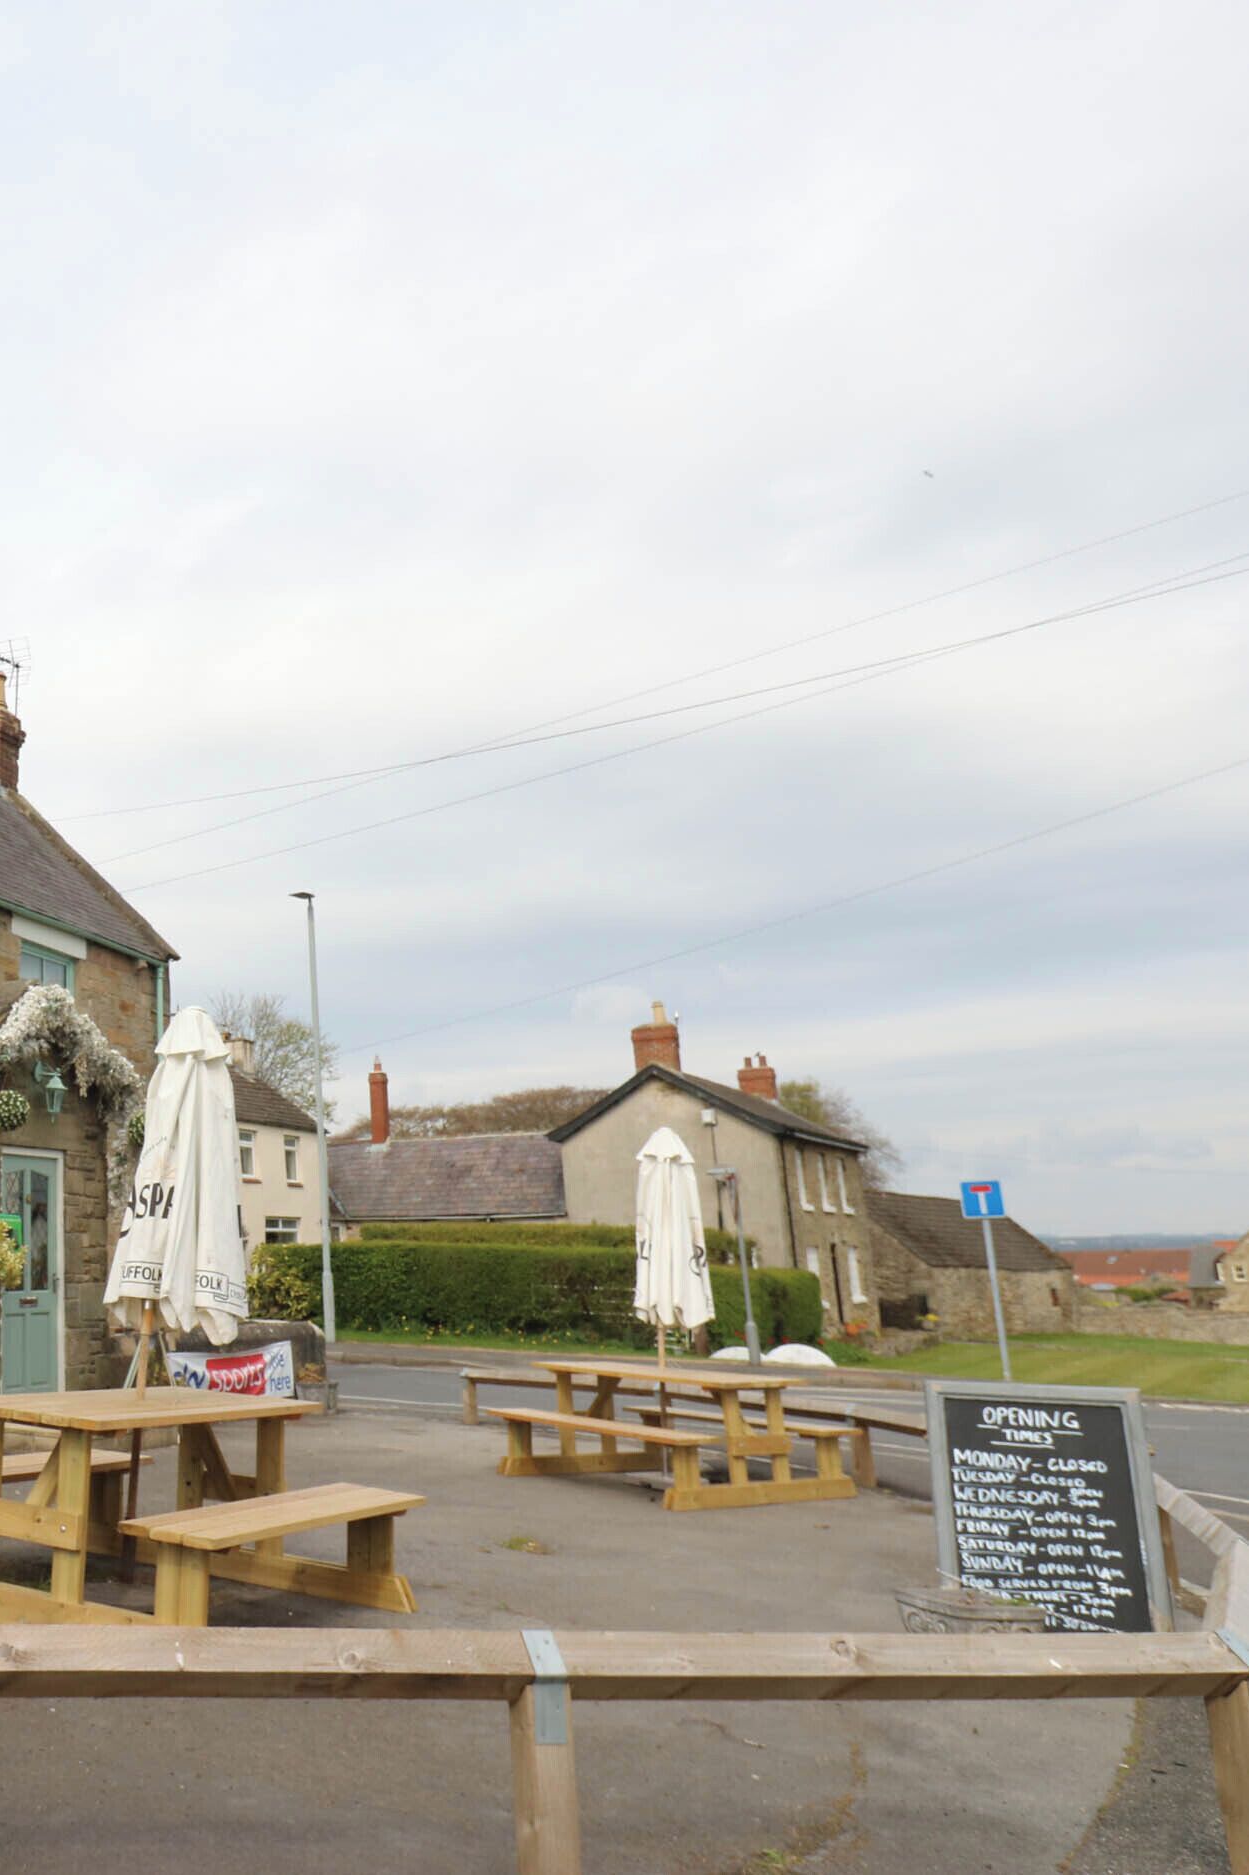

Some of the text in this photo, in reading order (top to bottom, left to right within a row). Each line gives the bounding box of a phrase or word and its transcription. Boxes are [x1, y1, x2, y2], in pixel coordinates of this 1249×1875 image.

[211, 1361, 264, 1392] sports
[270, 1374, 291, 1392] here
[982, 1406, 1080, 1429] OPENING
[1002, 1428, 1054, 1444] TIMES
[953, 1448, 1031, 1472] MONDAY
[1047, 1458, 1108, 1473] CLOSED
[952, 1468, 1017, 1484] TUESDAY
[1030, 1473, 1087, 1488] CLOSED
[953, 1485, 1060, 1506] WEDNESDAY
[954, 1502, 1036, 1526] THURSDAY
[1045, 1512, 1083, 1525] OPEN
[956, 1518, 1010, 1537] FRIDAY
[1030, 1527, 1068, 1538] OPEN
[958, 1535, 1037, 1556] SATURDAY
[1047, 1544, 1085, 1557] OPEN
[960, 1552, 1024, 1573] SUNDAY
[1038, 1563, 1077, 1576] OPEN
[960, 1574, 994, 1588] FOOD
[998, 1577, 1050, 1589] SERVED
[1051, 1579, 1094, 1591] FROM
